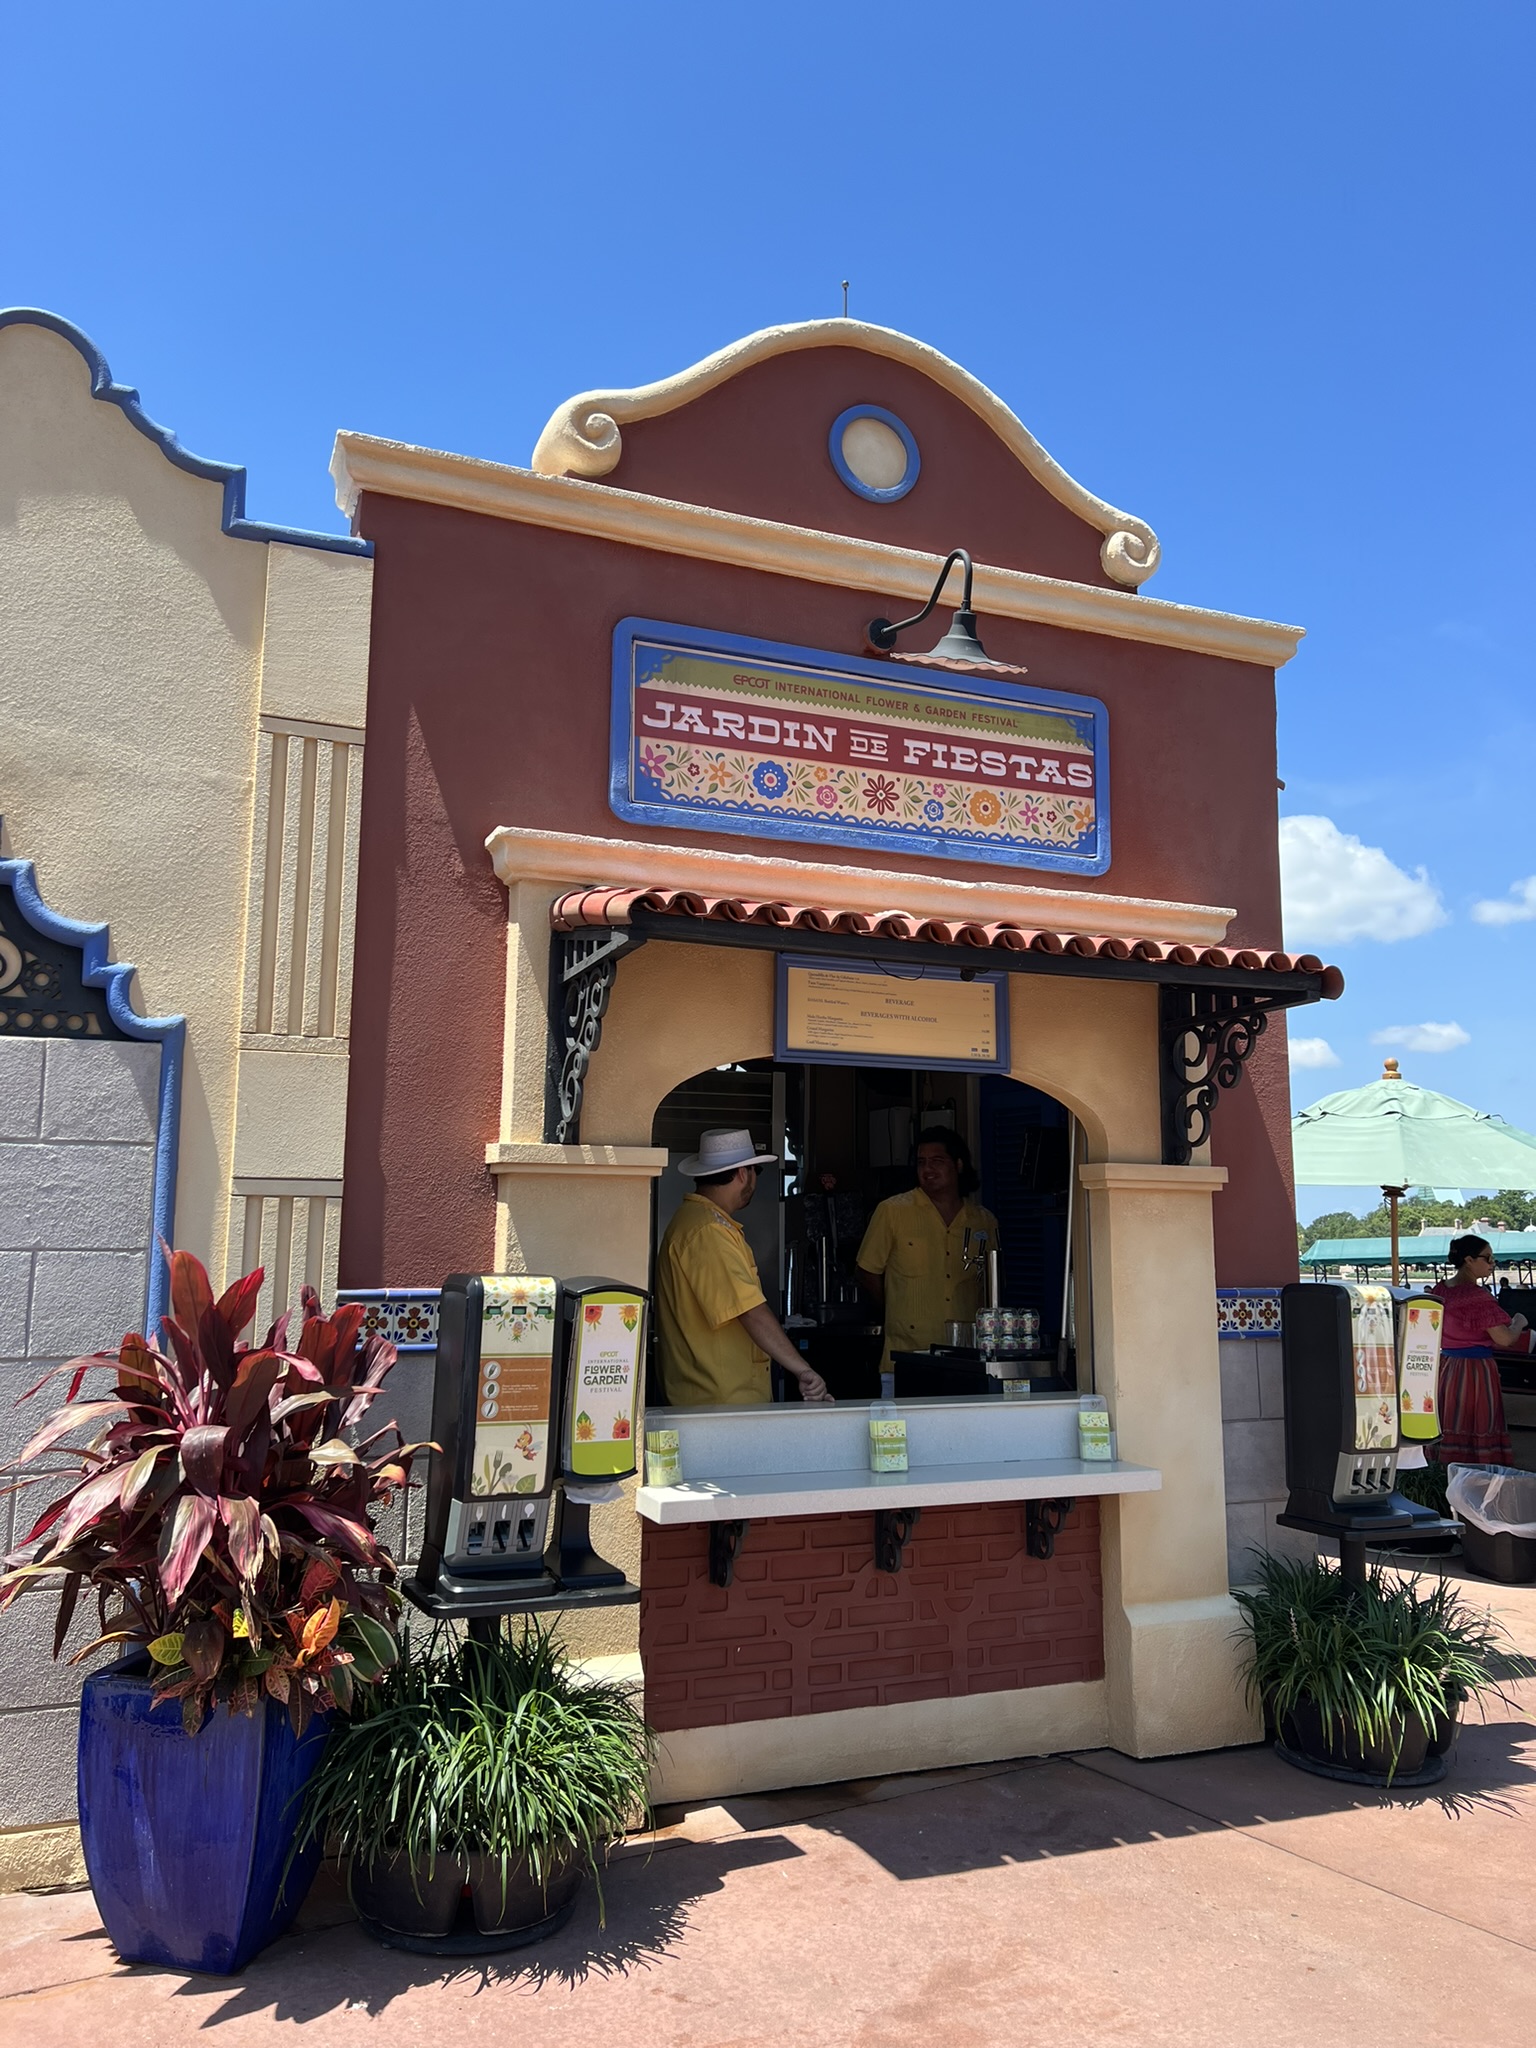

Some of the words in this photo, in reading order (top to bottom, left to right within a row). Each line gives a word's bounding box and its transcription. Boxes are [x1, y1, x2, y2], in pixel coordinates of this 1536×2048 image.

[733, 674, 770, 690] EPCOT
[775, 681, 861, 703] INTERNATIONAL
[866, 696, 908, 711] FLOWER
[913, 704, 920, 713] &
[925, 705, 967, 720] GARDEN
[972, 713, 1018, 728] FESTIVAL
[642, 701, 837, 752] JARDIN
[850, 735, 888, 755] DE
[903, 738, 1092, 788] FIESTAS
[893, 1013, 910, 1021] WITH
[911, 1015, 938, 1023] ALCOHOL
[1407, 1354, 1429, 1362] FLOWER
[584, 1364, 622, 1375] FLOWER
[1406, 1362, 1432, 1371] GARDEN
[583, 1374, 628, 1386] GARDEN
